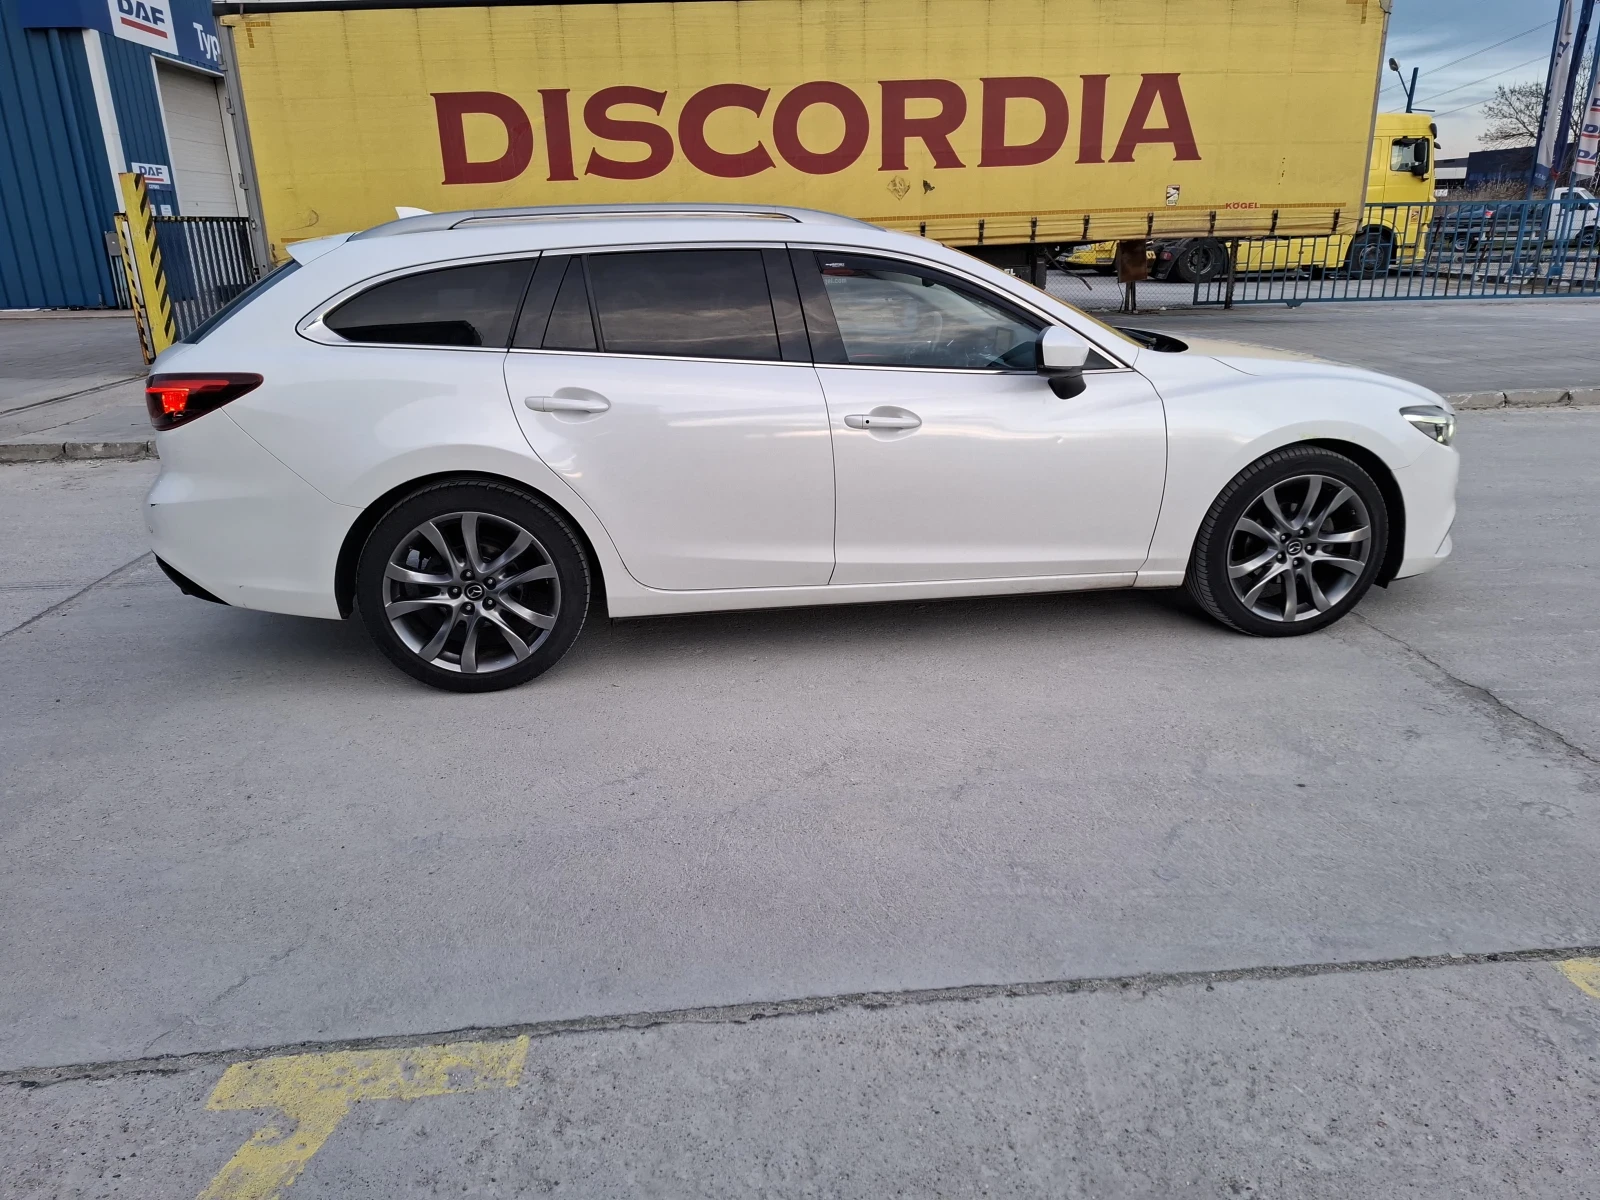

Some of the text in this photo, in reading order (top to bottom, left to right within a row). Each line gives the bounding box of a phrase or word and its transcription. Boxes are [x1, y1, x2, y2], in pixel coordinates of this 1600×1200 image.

[117, 0, 166, 25] DAF
[430, 72, 1202, 185] DISCORDIA
[138, 165, 163, 176] DAF
